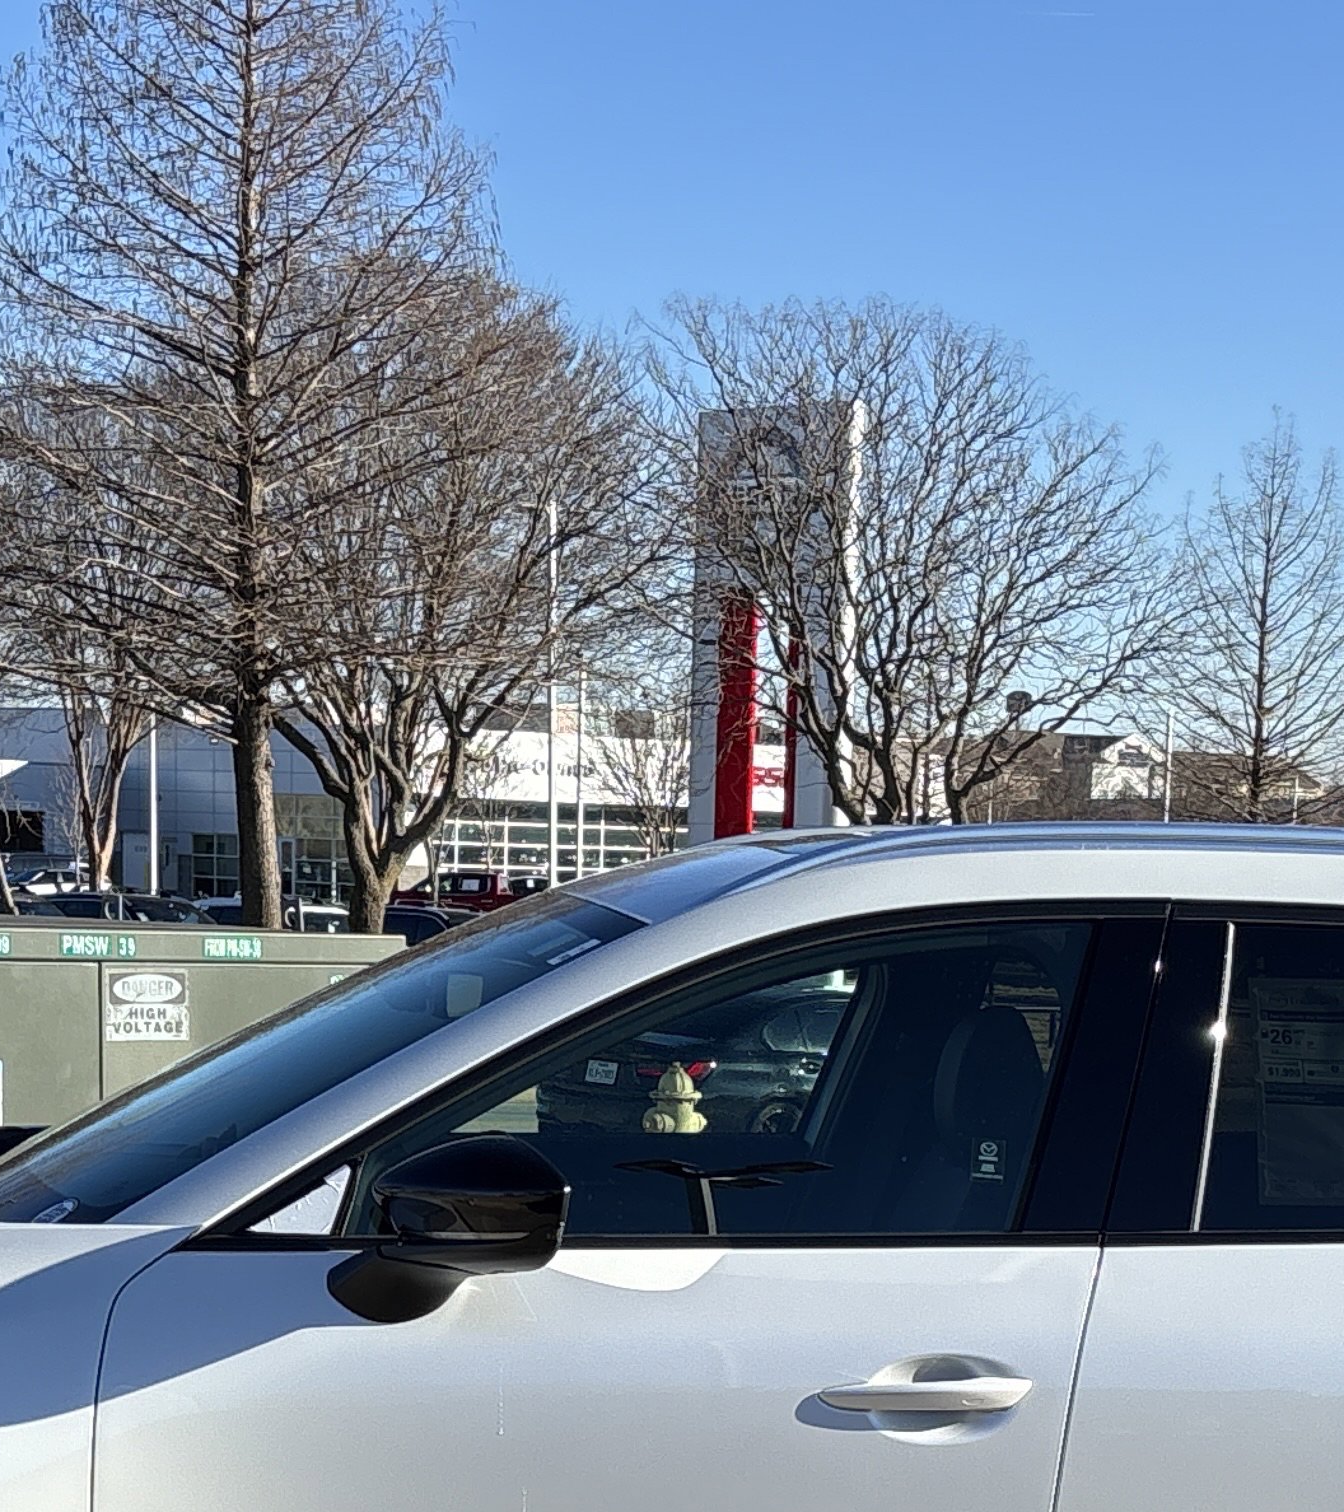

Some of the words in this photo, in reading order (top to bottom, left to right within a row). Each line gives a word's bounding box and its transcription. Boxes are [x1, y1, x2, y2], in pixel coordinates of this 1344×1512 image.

[63, 935, 109, 956] PMSW
[121, 980, 174, 996] DANGER
[129, 1008, 167, 1020] HIGH
[112, 1021, 184, 1034] VOLTAGE
[1269, 1028, 1293, 1045] 26
